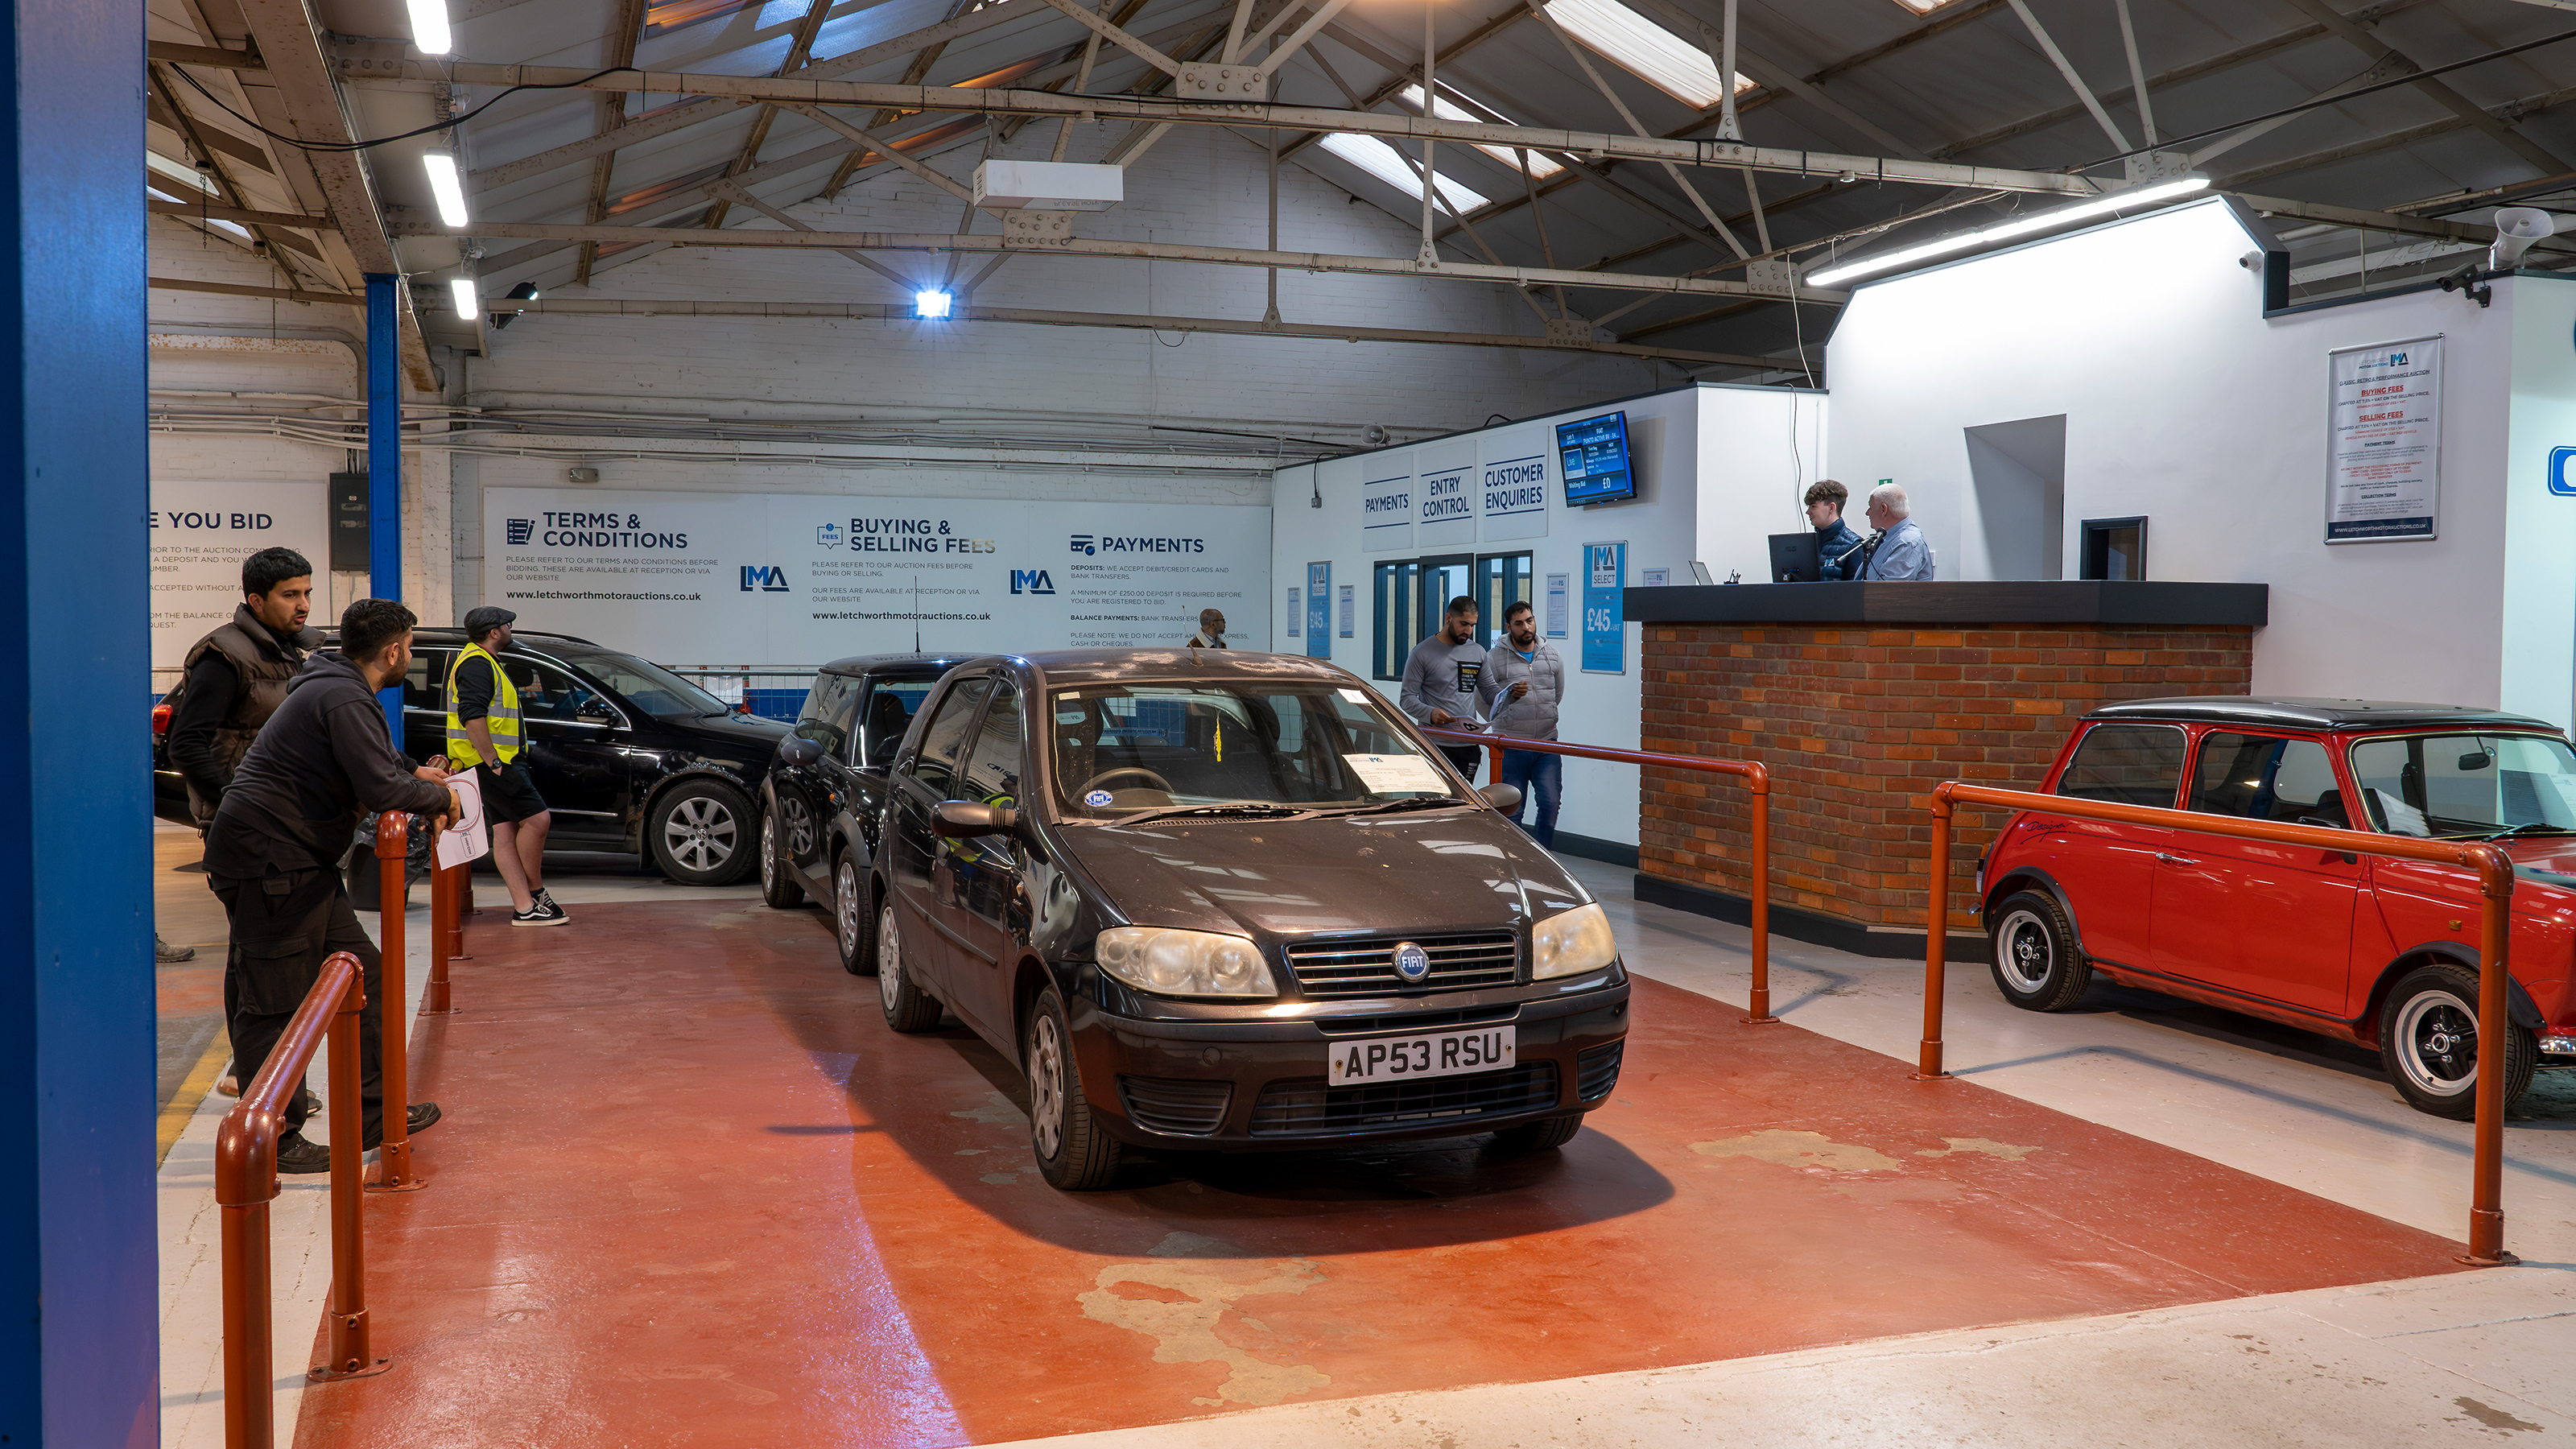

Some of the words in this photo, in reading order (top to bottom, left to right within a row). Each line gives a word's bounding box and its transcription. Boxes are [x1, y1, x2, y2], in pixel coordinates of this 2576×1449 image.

[2390, 353, 2409, 367] LMA
[2361, 387, 2386, 397] BUYING
[2388, 385, 2405, 394] FEES
[2359, 413, 2386, 423] SELLING
[2387, 411, 2404, 419] FEES
[1484, 462, 1544, 488] CUSTOMER
[1603, 477, 1611, 489] £0
[1430, 476, 1461, 496] ENTRY
[1365, 493, 1409, 514] PAYMENTS
[1422, 496, 1470, 518] CONTROL
[1486, 486, 1542, 510] ENQUIRIES
[167, 511, 221, 529] YOU
[230, 513, 272, 529] BID
[543, 511, 619, 529] TERMS
[626, 514, 640, 529] &
[851, 518, 931, 535] BUYING
[938, 519, 951, 535] &
[543, 530, 687, 548] CONDITIONS
[851, 536, 938, 552] SELLING
[946, 538, 995, 553] FEES
[1102, 537, 1203, 553] PAYMENTS
[506, 564, 539, 574] BIDDING.
[740, 565, 789, 592] LMA
[1009, 569, 1055, 594] LMA
[1593, 574, 1616, 584] SELECT
[506, 589, 700, 601] www.letchworthmotorauctions.co.uk
[812, 611, 990, 620] www.letchworthmotorauctions.co.uk
[1310, 611, 1323, 629] £45
[1587, 608, 1611, 632] £45
[2021, 820, 2072, 843] Designer
[1402, 956, 1423, 968] FIAT
[1345, 1040, 1430, 1077] AP53
[1441, 1032, 1501, 1069] RSU
